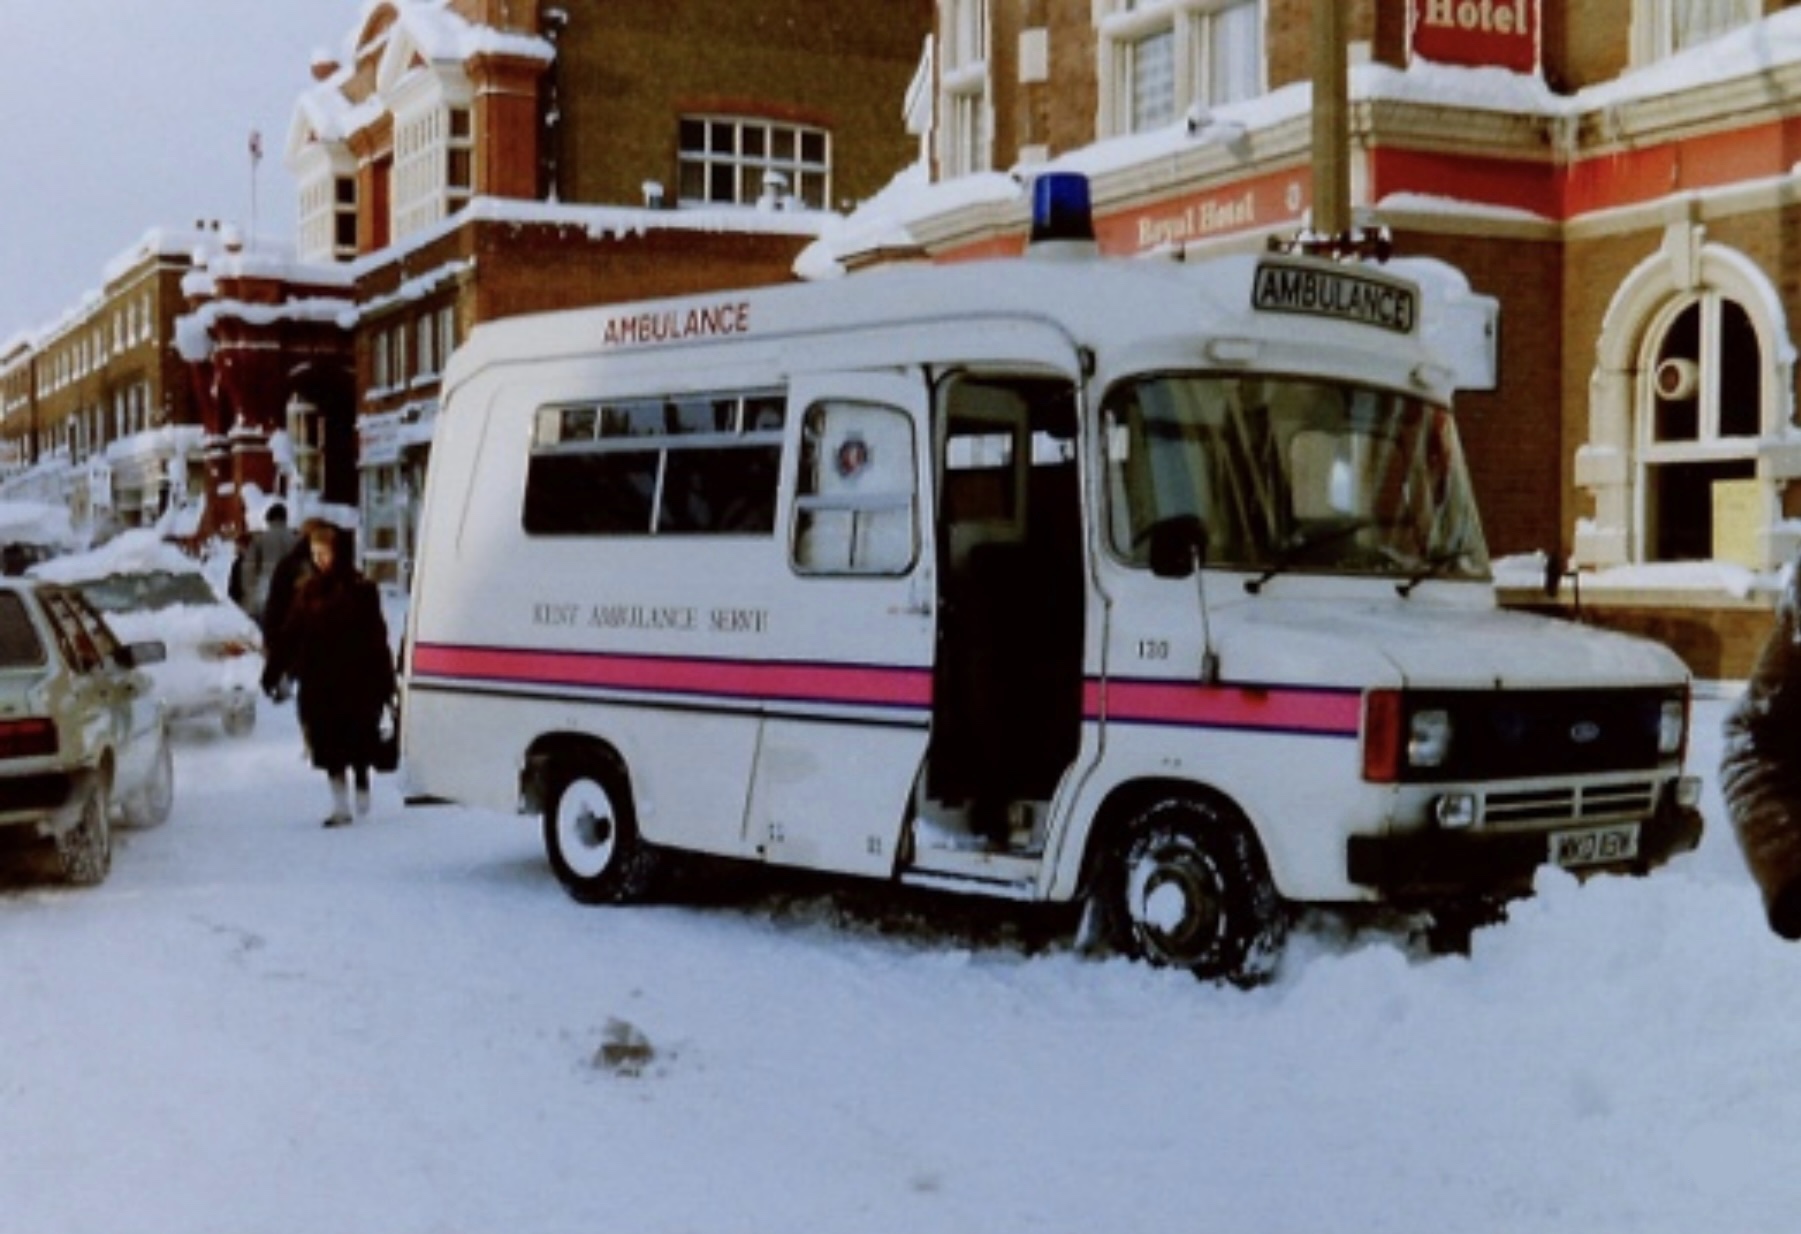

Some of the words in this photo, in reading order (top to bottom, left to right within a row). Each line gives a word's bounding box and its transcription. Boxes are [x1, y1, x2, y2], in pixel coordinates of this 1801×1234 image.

[1424, 0, 1528, 35] Hotel
[1202, 190, 1255, 232] Hotel
[1260, 267, 1409, 328] AMBULANCE
[603, 302, 750, 345] AMBULANCE
[588, 604, 698, 631] AMBULANCE
